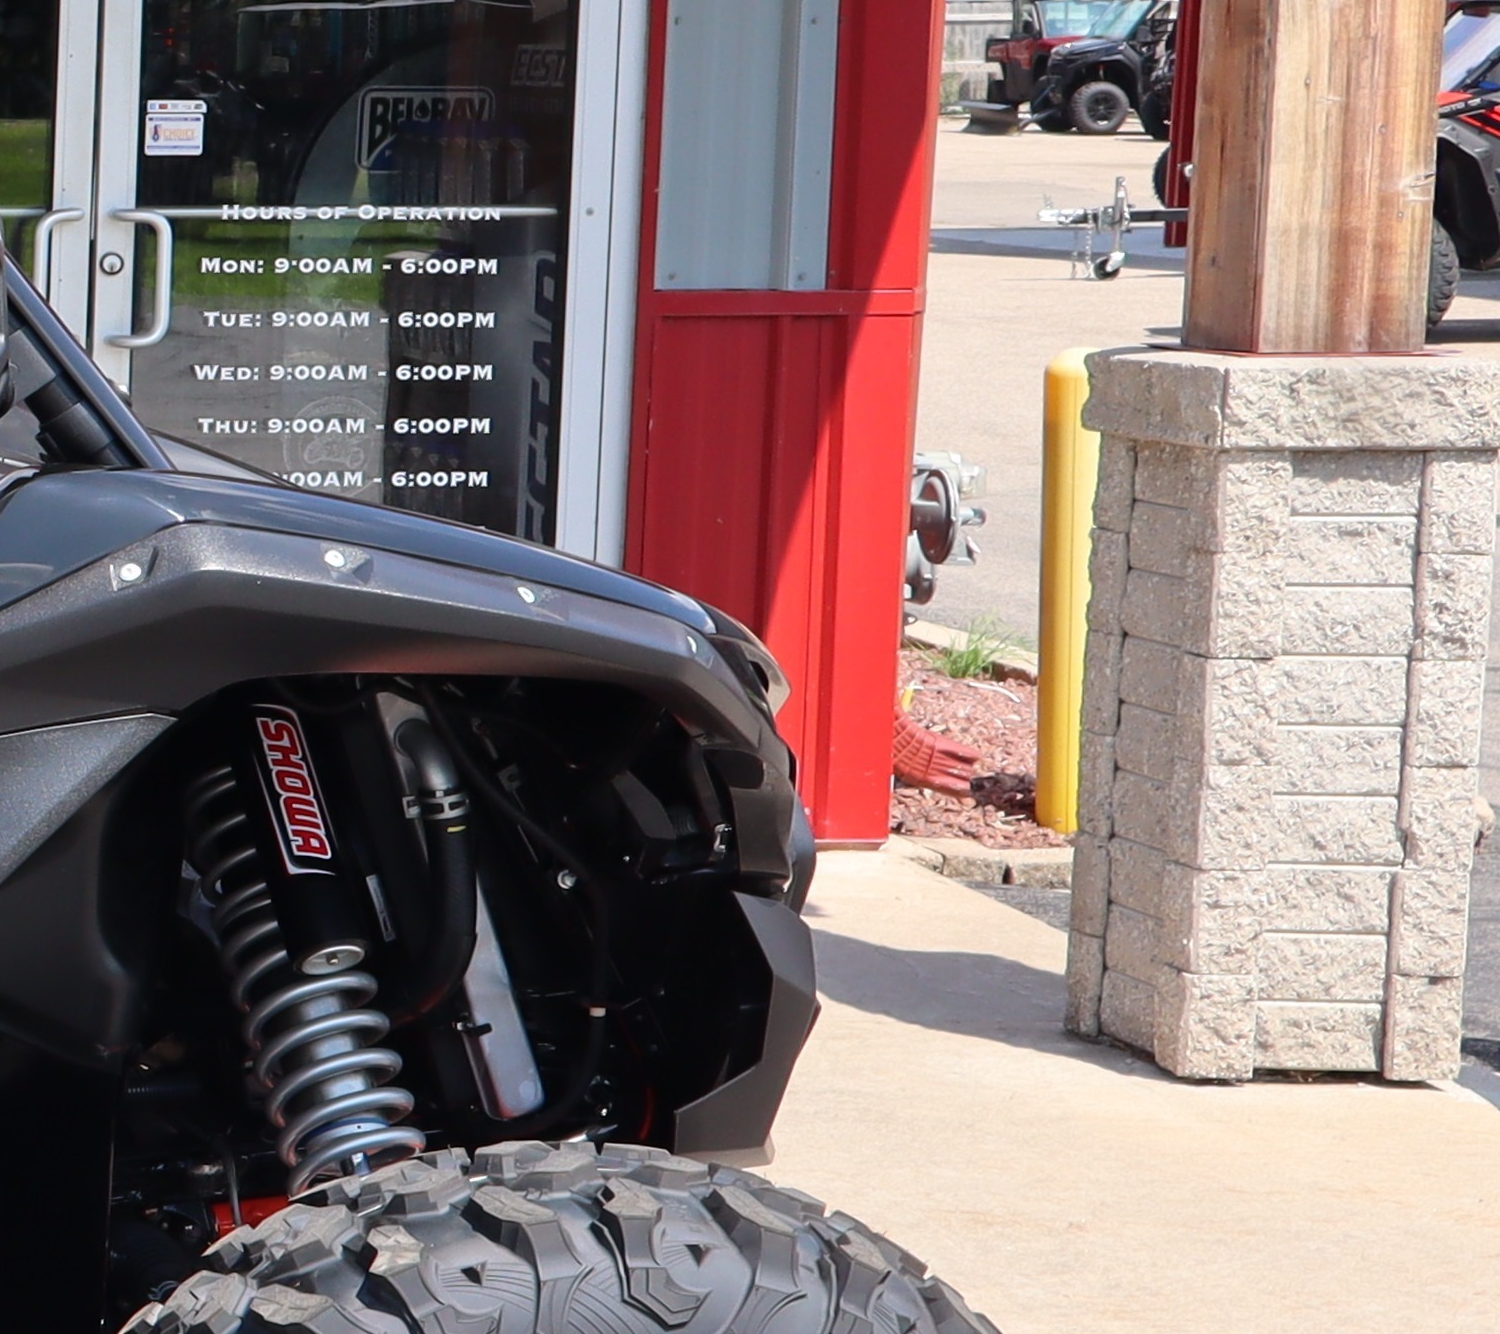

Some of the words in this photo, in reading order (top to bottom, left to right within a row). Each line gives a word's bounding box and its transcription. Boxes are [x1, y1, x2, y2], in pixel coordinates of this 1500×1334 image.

[401, 257, 499, 274] 6:00PM
[271, 311, 370, 328] 9:00AM
[397, 312, 496, 328] 6:00PM
[269, 365, 368, 381] 9:00AM
[395, 365, 493, 381] 6:00PM
[267, 418, 365, 434] 9:00AM
[393, 418, 491, 434] 6:00PM
[273, 471, 363, 487] :00AM
[391, 471, 489, 487] 6:00PM
[255, 716, 333, 860] SHOWA
